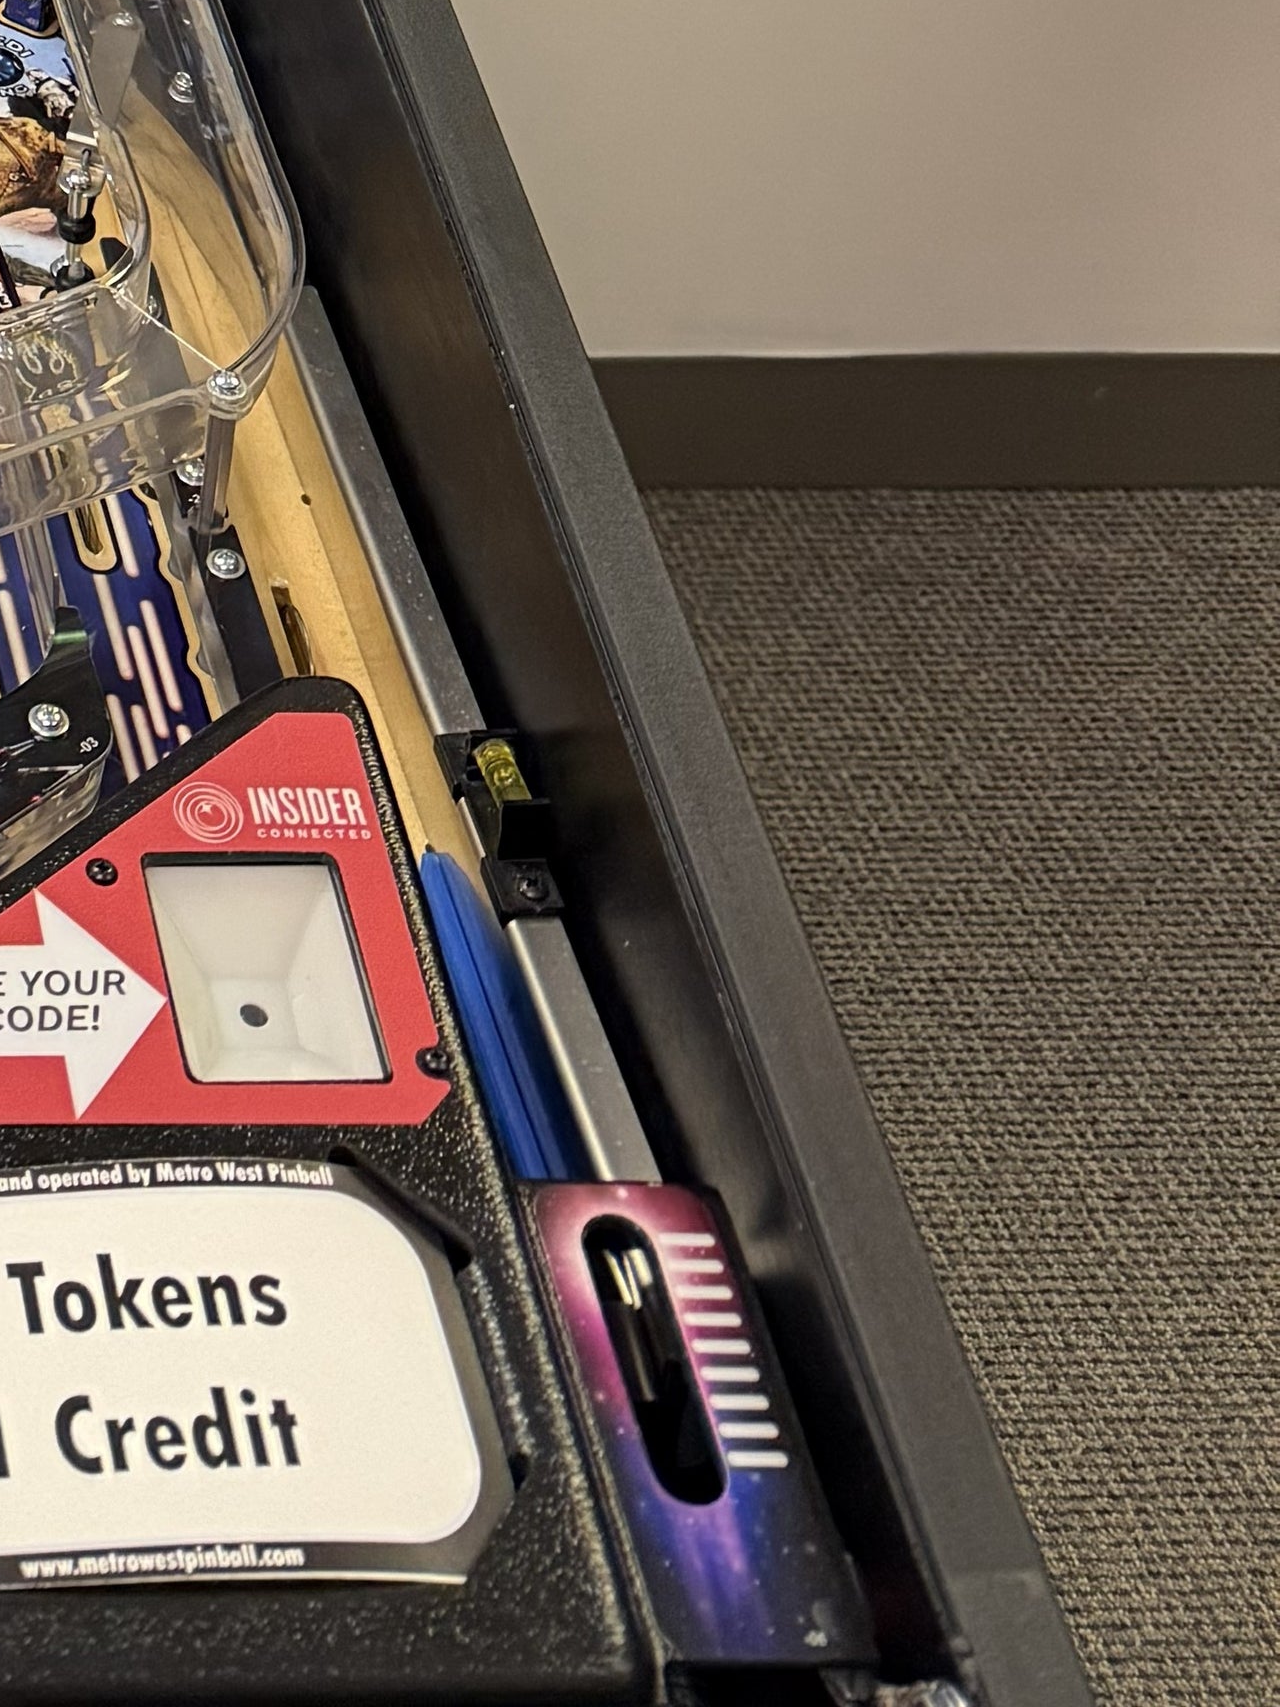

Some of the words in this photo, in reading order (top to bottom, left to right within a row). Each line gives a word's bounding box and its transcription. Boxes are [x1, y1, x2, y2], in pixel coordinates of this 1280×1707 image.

[247, 787, 367, 826] INSIDER
[256, 828, 372, 840] CONNECTED
[20, 969, 127, 997] YOUR
[37, 1164, 122, 1192] operated
[127, 1164, 150, 1187] by
[156, 1163, 213, 1183] Metro
[215, 1162, 263, 1182] West
[268, 1164, 334, 1186] Pinball
[5, 1253, 289, 1337] Tokens
[54, 1386, 302, 1475] Credit
[20, 1546, 305, 1580] www.metrowestpinball.com
